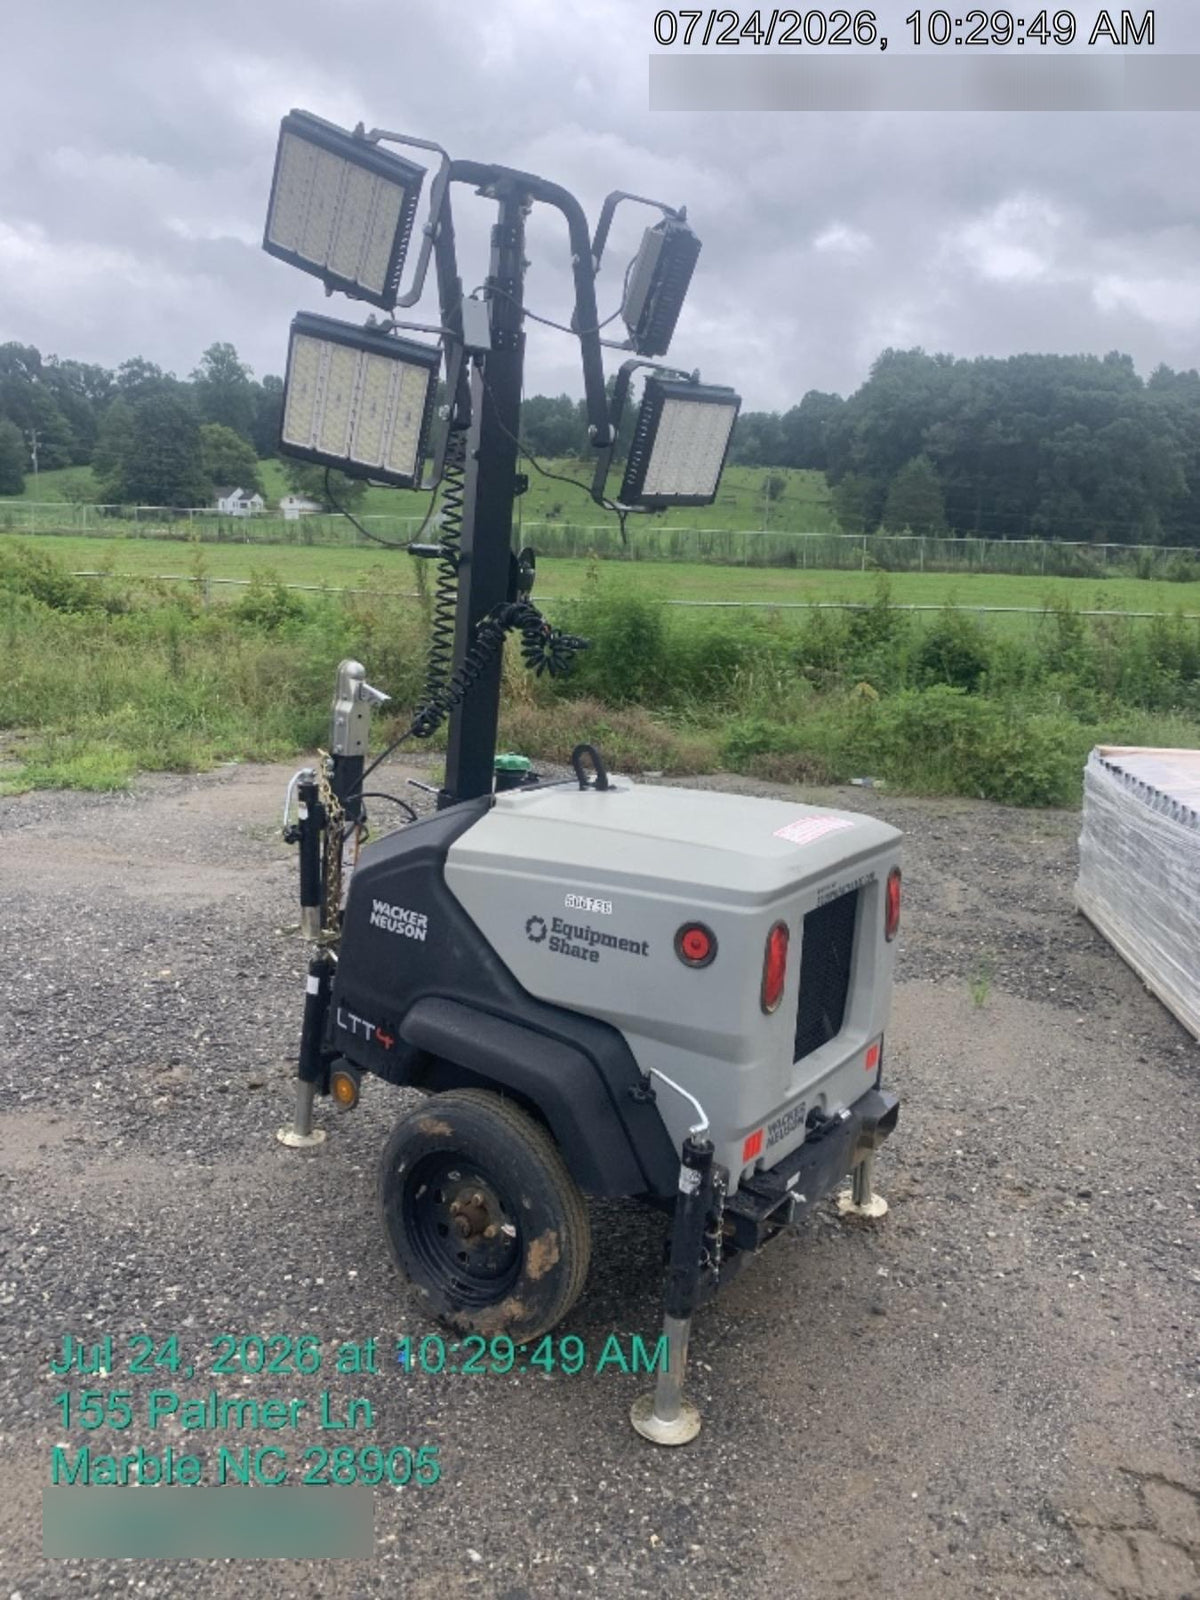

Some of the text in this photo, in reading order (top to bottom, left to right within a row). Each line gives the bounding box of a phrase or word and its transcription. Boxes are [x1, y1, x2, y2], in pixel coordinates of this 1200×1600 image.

[370, 911, 428, 942] NEUSON
[372, 898, 428, 929] WACKER
[548, 935, 600, 963] Share
[550, 916, 650, 957] Equipment
[336, 1006, 395, 1050] LTT4
